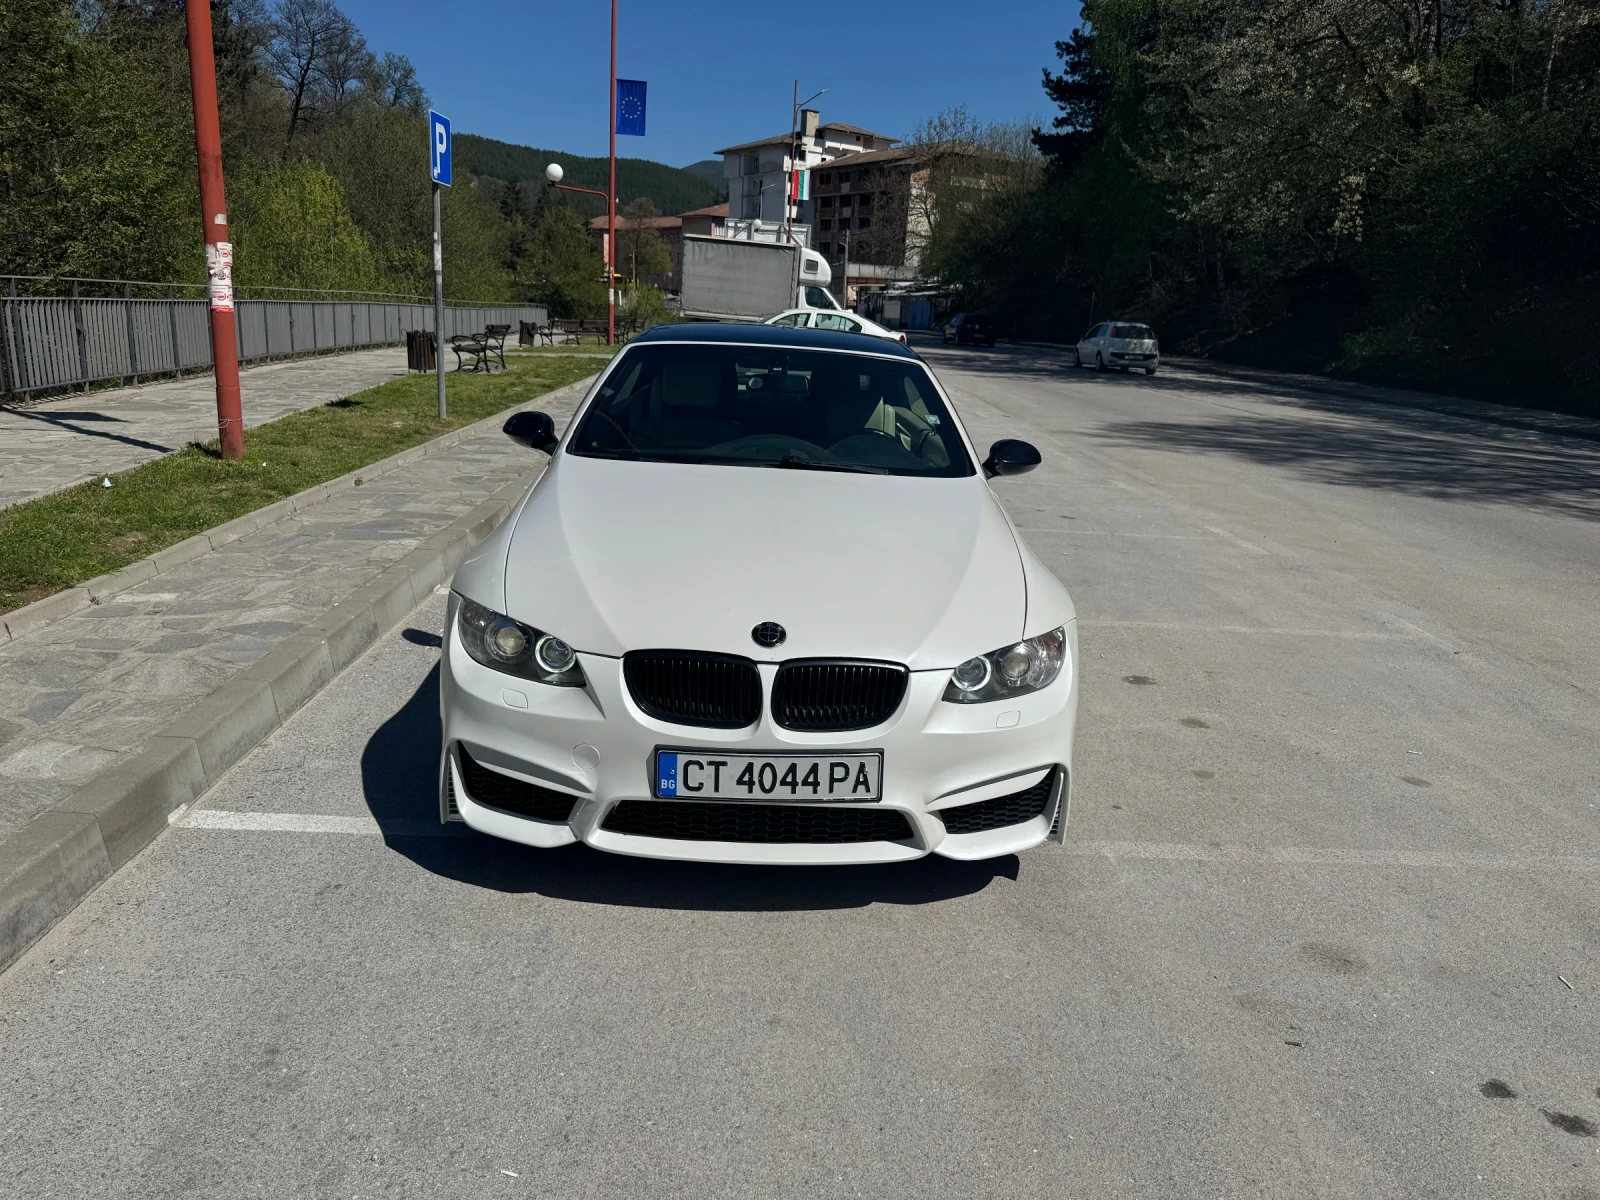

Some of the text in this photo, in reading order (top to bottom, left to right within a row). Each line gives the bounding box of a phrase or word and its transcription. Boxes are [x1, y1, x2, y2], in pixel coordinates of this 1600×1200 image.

[436, 122, 447, 173] P
[661, 780, 675, 789] BG
[683, 760, 871, 794] CT 4044 PA
